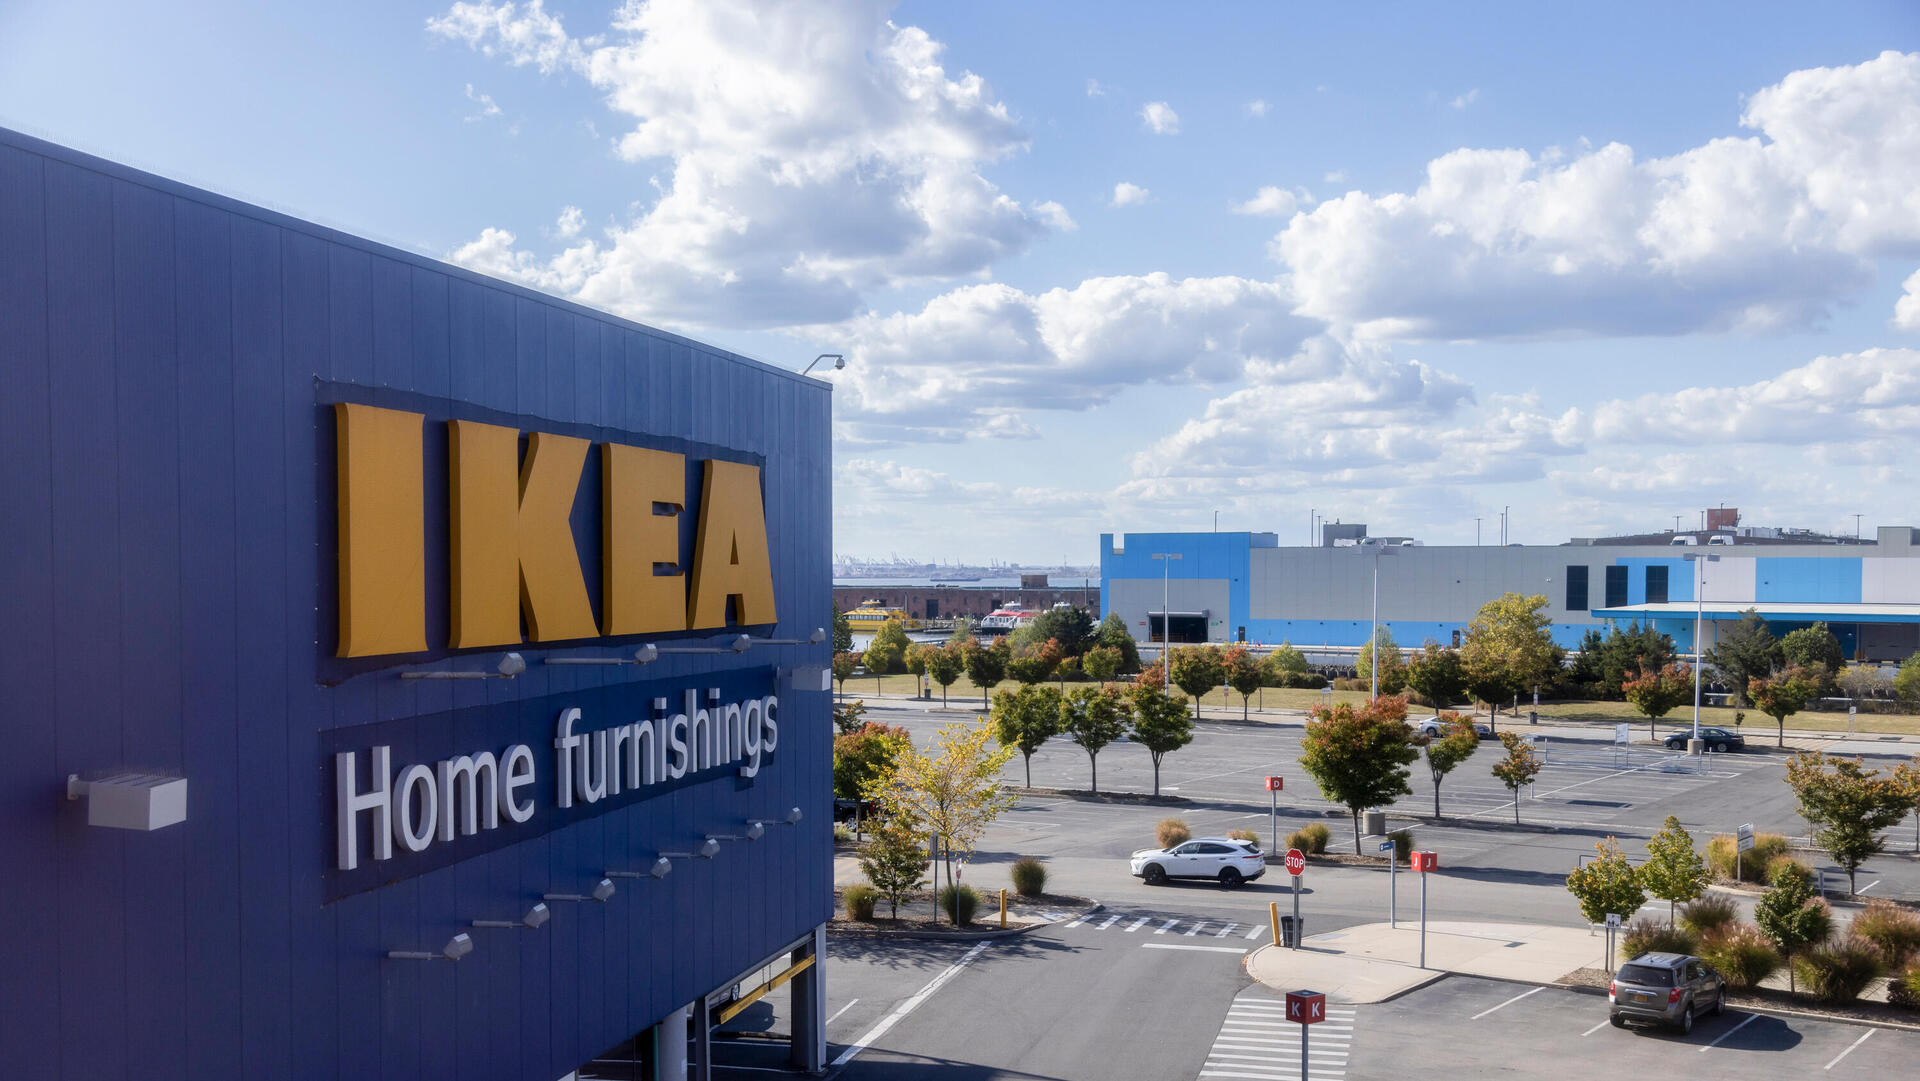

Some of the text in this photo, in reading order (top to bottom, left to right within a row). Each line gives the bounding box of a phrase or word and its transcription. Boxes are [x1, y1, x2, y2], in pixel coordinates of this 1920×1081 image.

[335, 402, 778, 658] IKEA
[336, 688, 778, 870] Home furnishings
[1273, 780, 1280, 788] D
[1286, 856, 1304, 868] STOP
[1414, 856, 1418, 867] J
[1426, 857, 1431, 868] J
[1291, 1001, 1301, 1017] K
[1311, 1002, 1320, 1017] K
